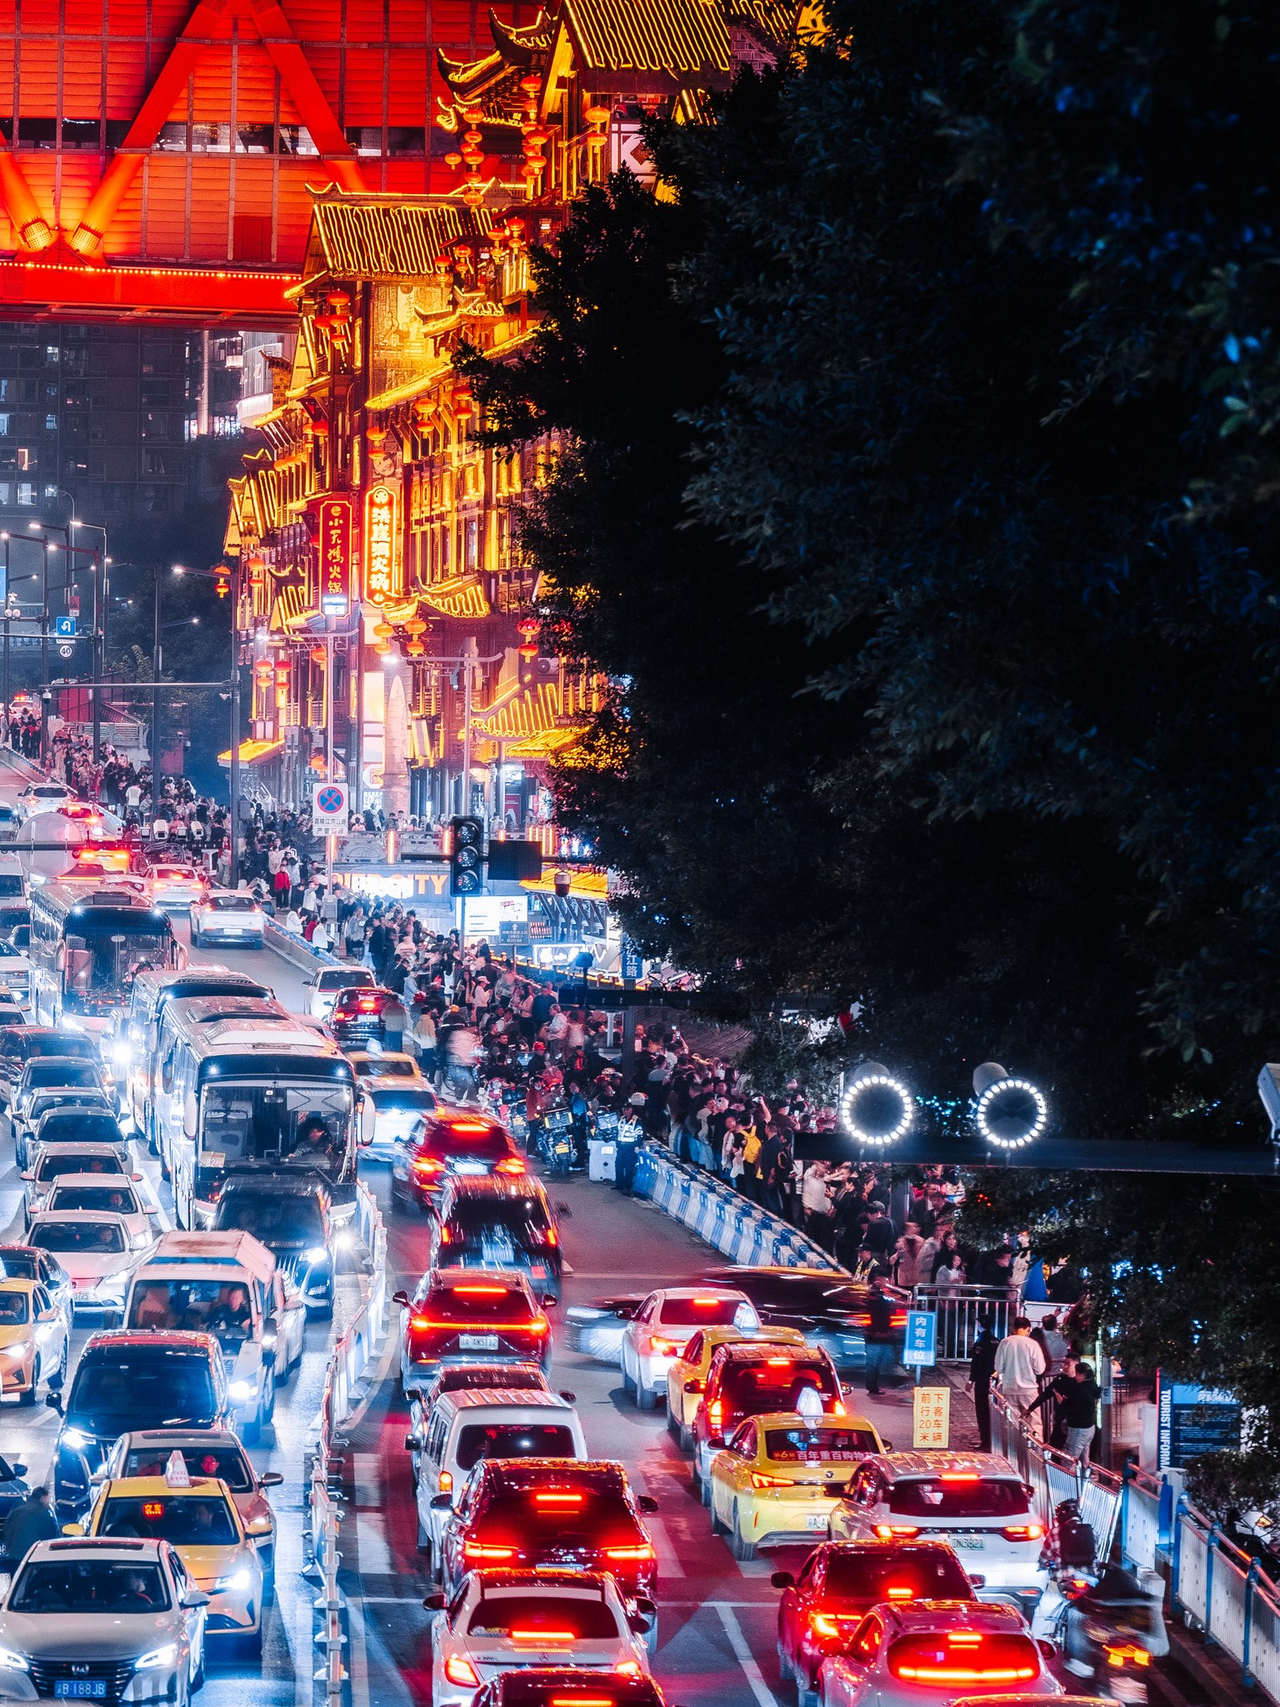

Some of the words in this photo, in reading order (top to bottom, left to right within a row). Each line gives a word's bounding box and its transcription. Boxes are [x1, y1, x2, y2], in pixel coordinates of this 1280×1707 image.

[327, 517, 345, 595] 小天鹅火锅
[368, 506, 391, 592] 洪崖洞火锅
[61, 647, 71, 655] 40
[389, 874, 449, 895] TY
[913, 1316, 928, 1360] 内有车位
[919, 1393, 932, 1442] 前行20米
[932, 1393, 944, 1442] 下客车辆
[1160, 1389, 1172, 1428] TOURIST
